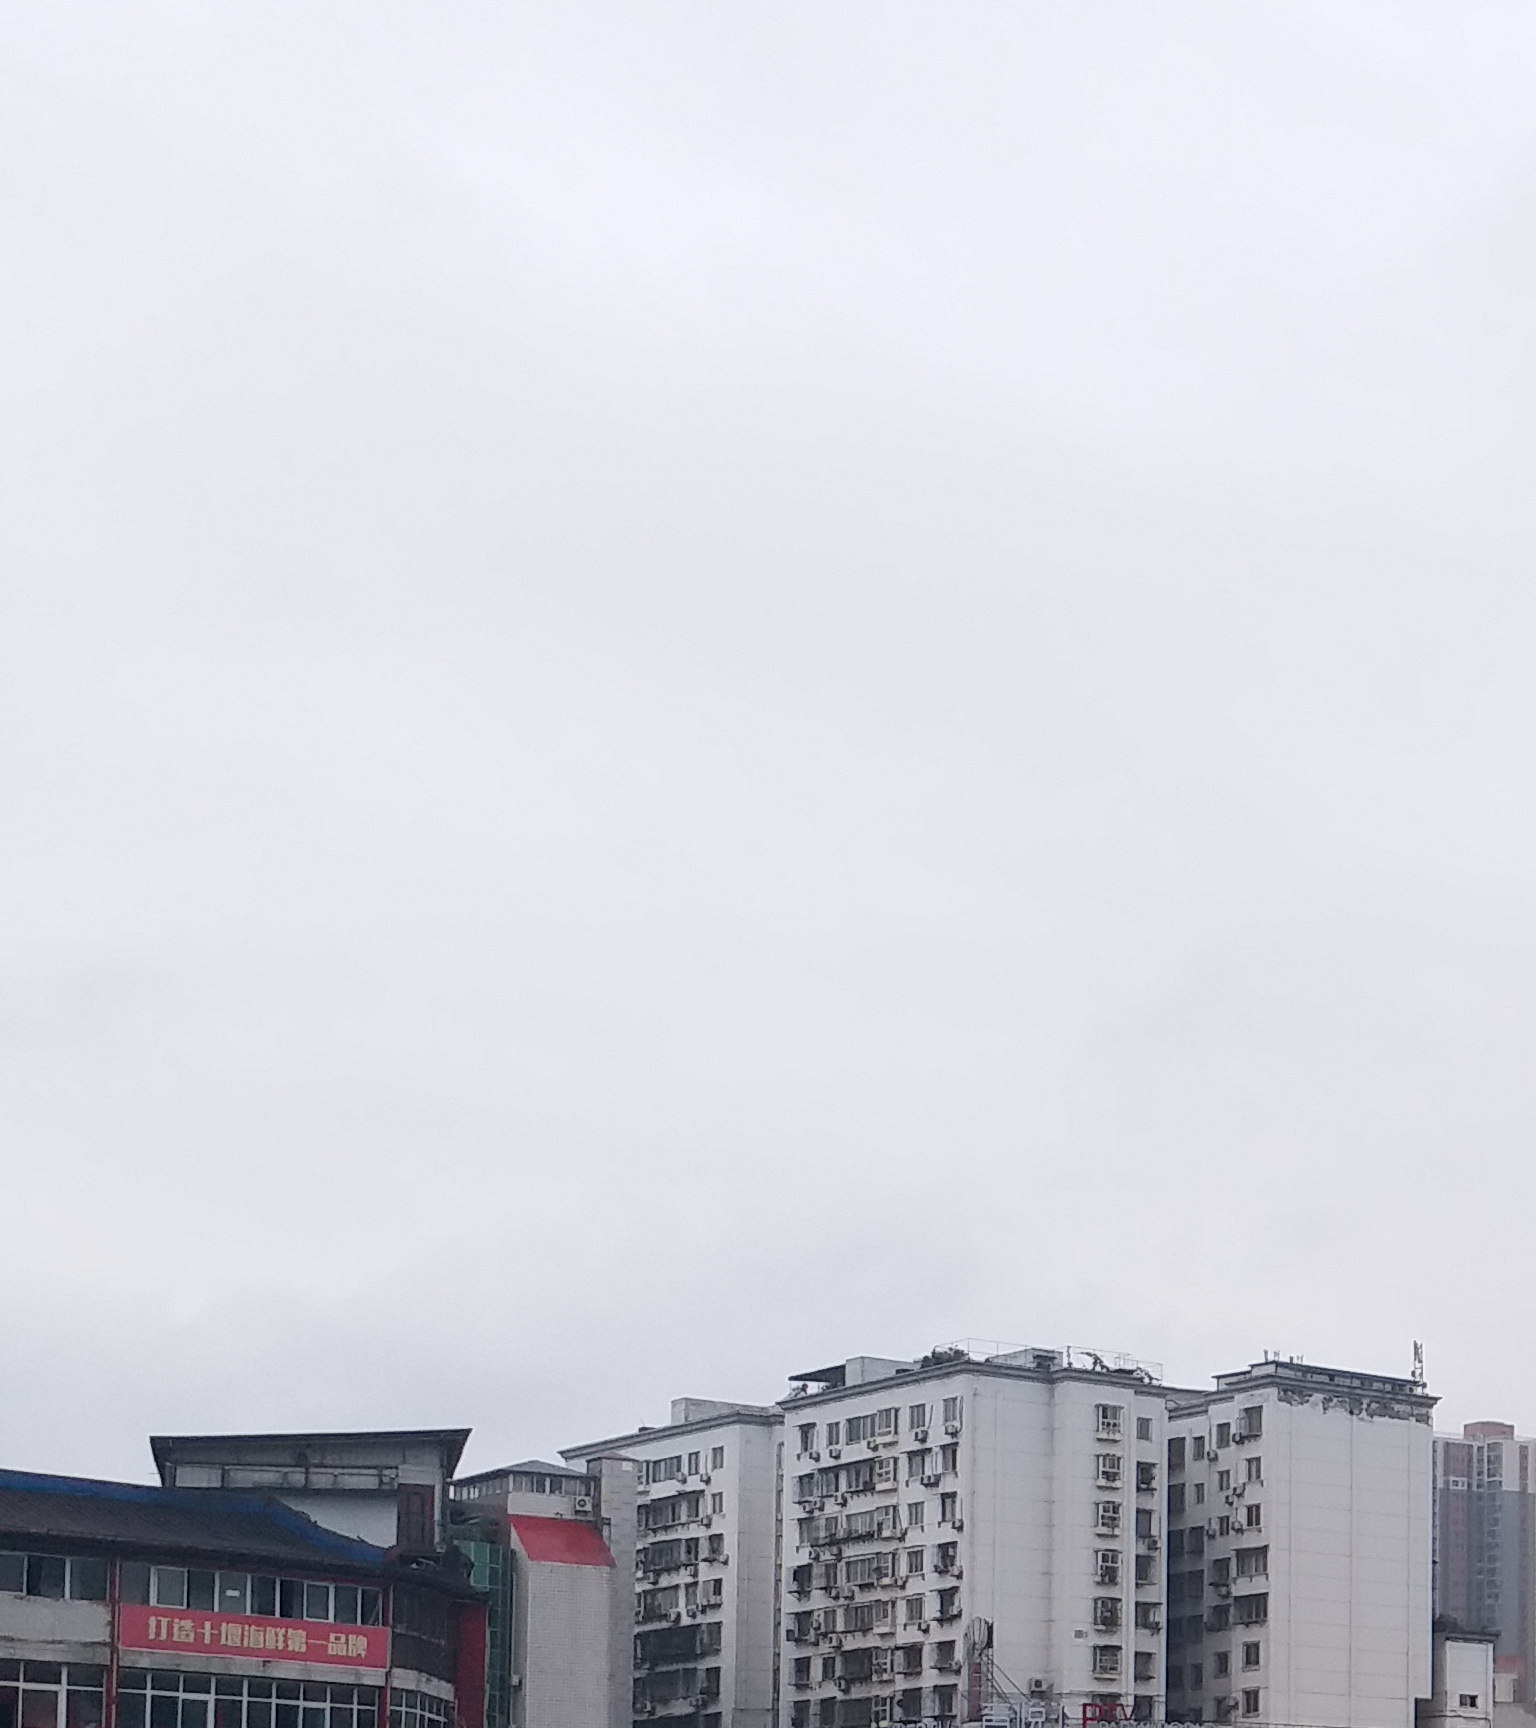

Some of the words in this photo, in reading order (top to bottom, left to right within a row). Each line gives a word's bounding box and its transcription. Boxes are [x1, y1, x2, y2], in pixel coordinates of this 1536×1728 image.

[148, 1616, 368, 1658] 打造十堰海鲜第一品牌
